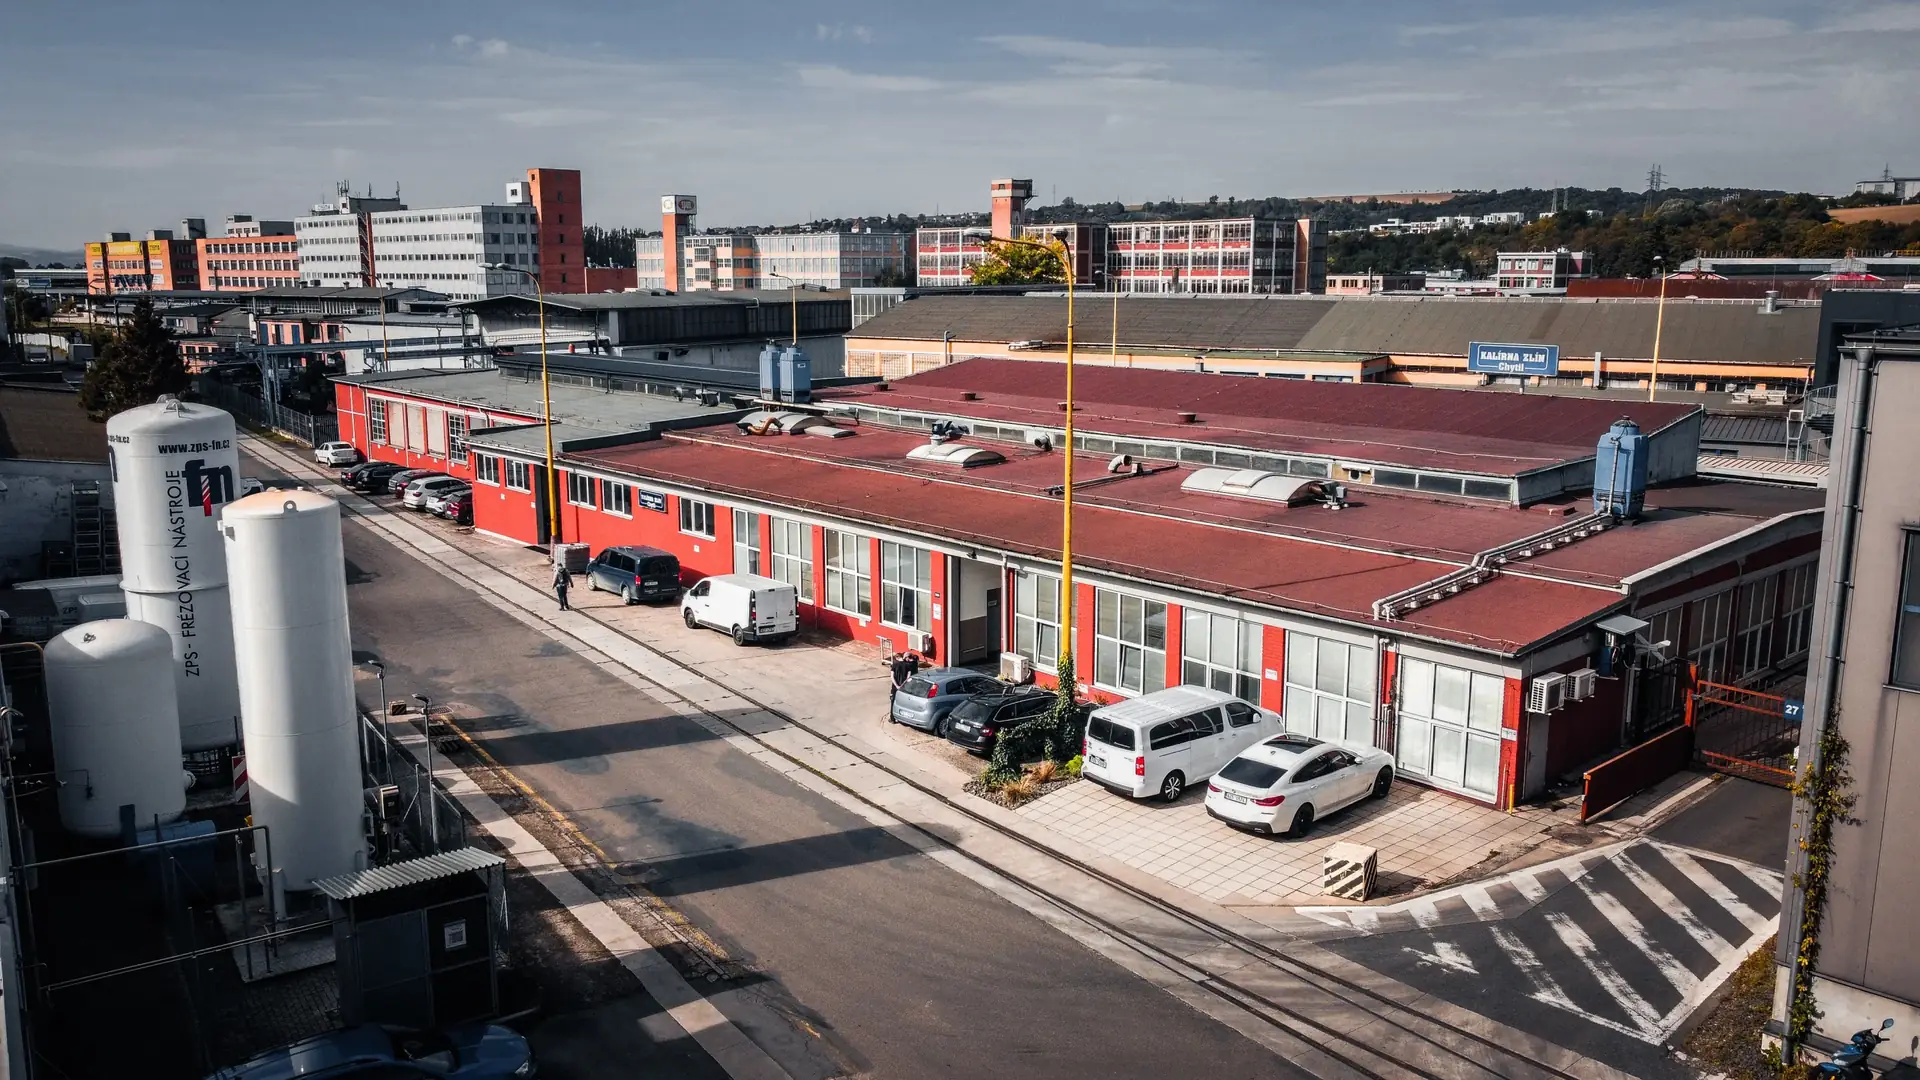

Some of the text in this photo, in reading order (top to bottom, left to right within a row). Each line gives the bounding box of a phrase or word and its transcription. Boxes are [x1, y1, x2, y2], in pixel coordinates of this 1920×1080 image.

[1481, 350, 1545, 363] KALÍRNA ZLÍN
[1498, 362, 1524, 372] Chytil
[158, 440, 230, 453] www.zps-fn.cz
[166, 470, 187, 548] NÁSTROJE
[170, 556, 196, 637] FRÉZOVACÍ
[184, 652, 200, 677] ZPS
[1785, 704, 1800, 715] 27
